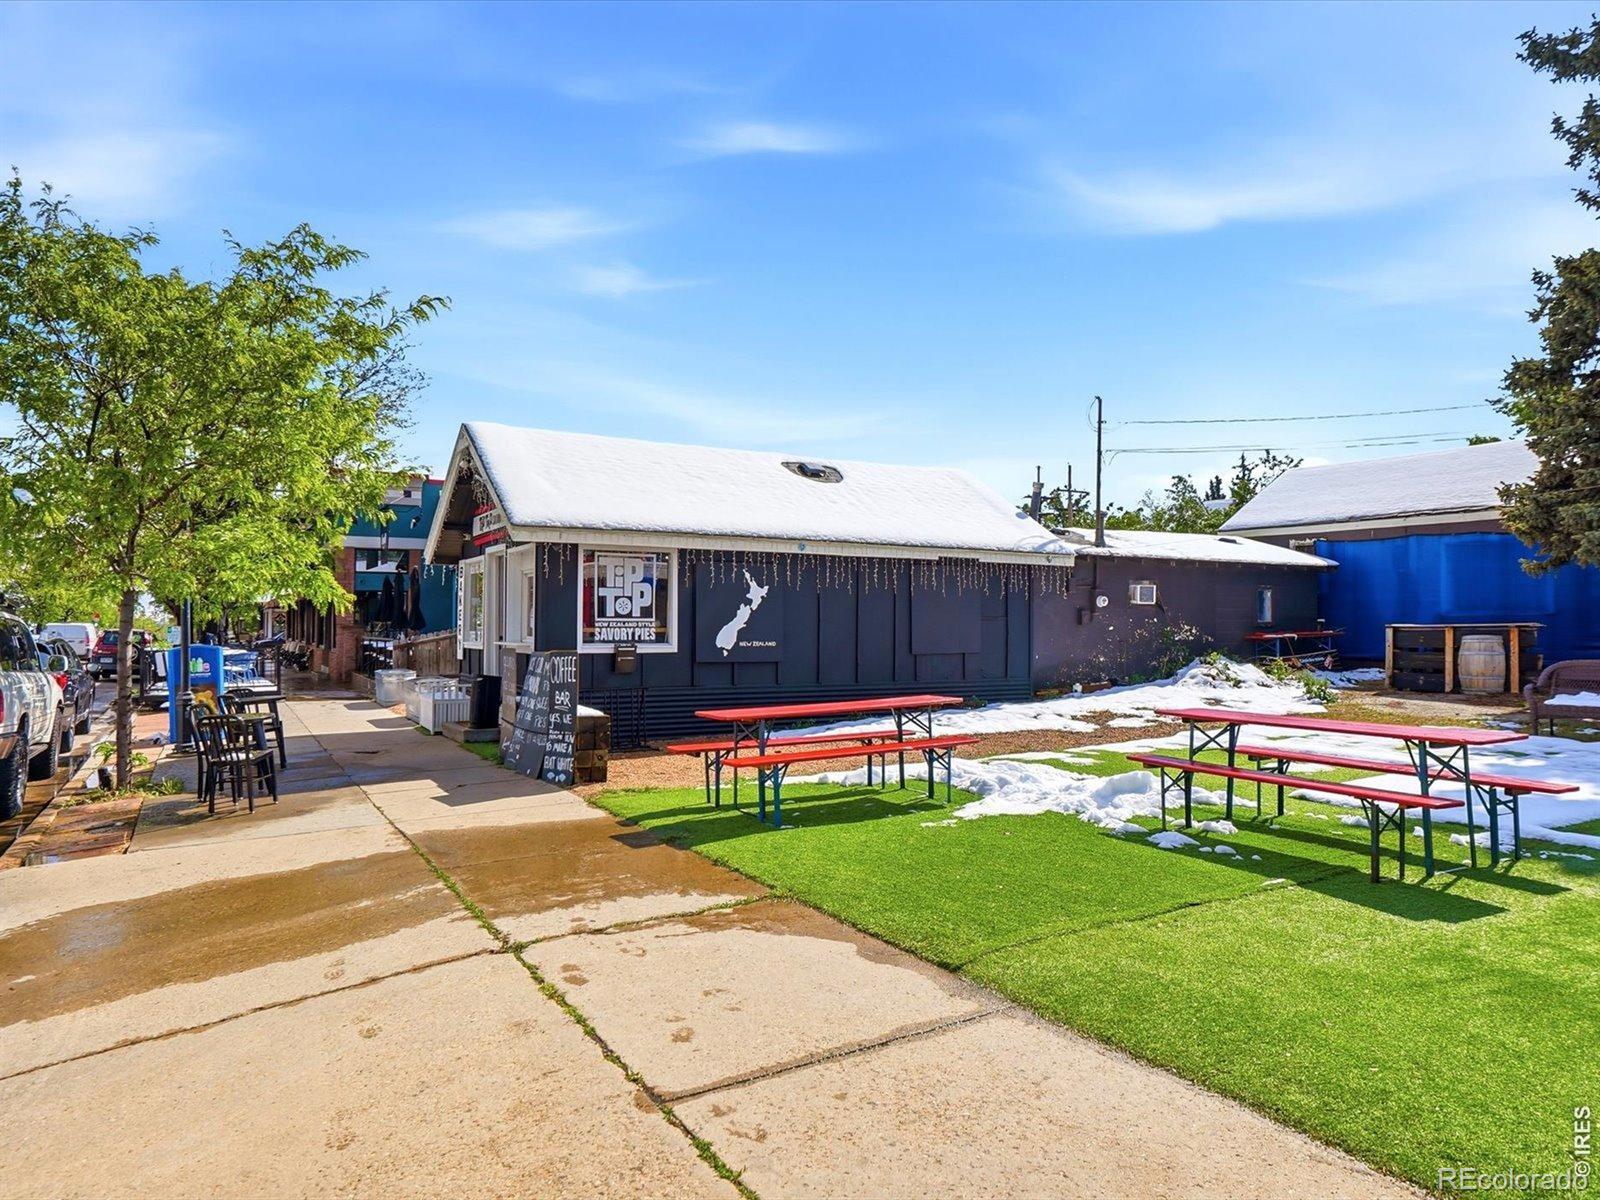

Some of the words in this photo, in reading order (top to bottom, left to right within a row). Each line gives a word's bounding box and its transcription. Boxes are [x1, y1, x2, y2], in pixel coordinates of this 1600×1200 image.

[594, 627, 634, 641] SAVORY
[635, 628, 656, 641] PIES
[550, 656, 577, 684] COFFEE
[555, 691, 572, 707] BAR
